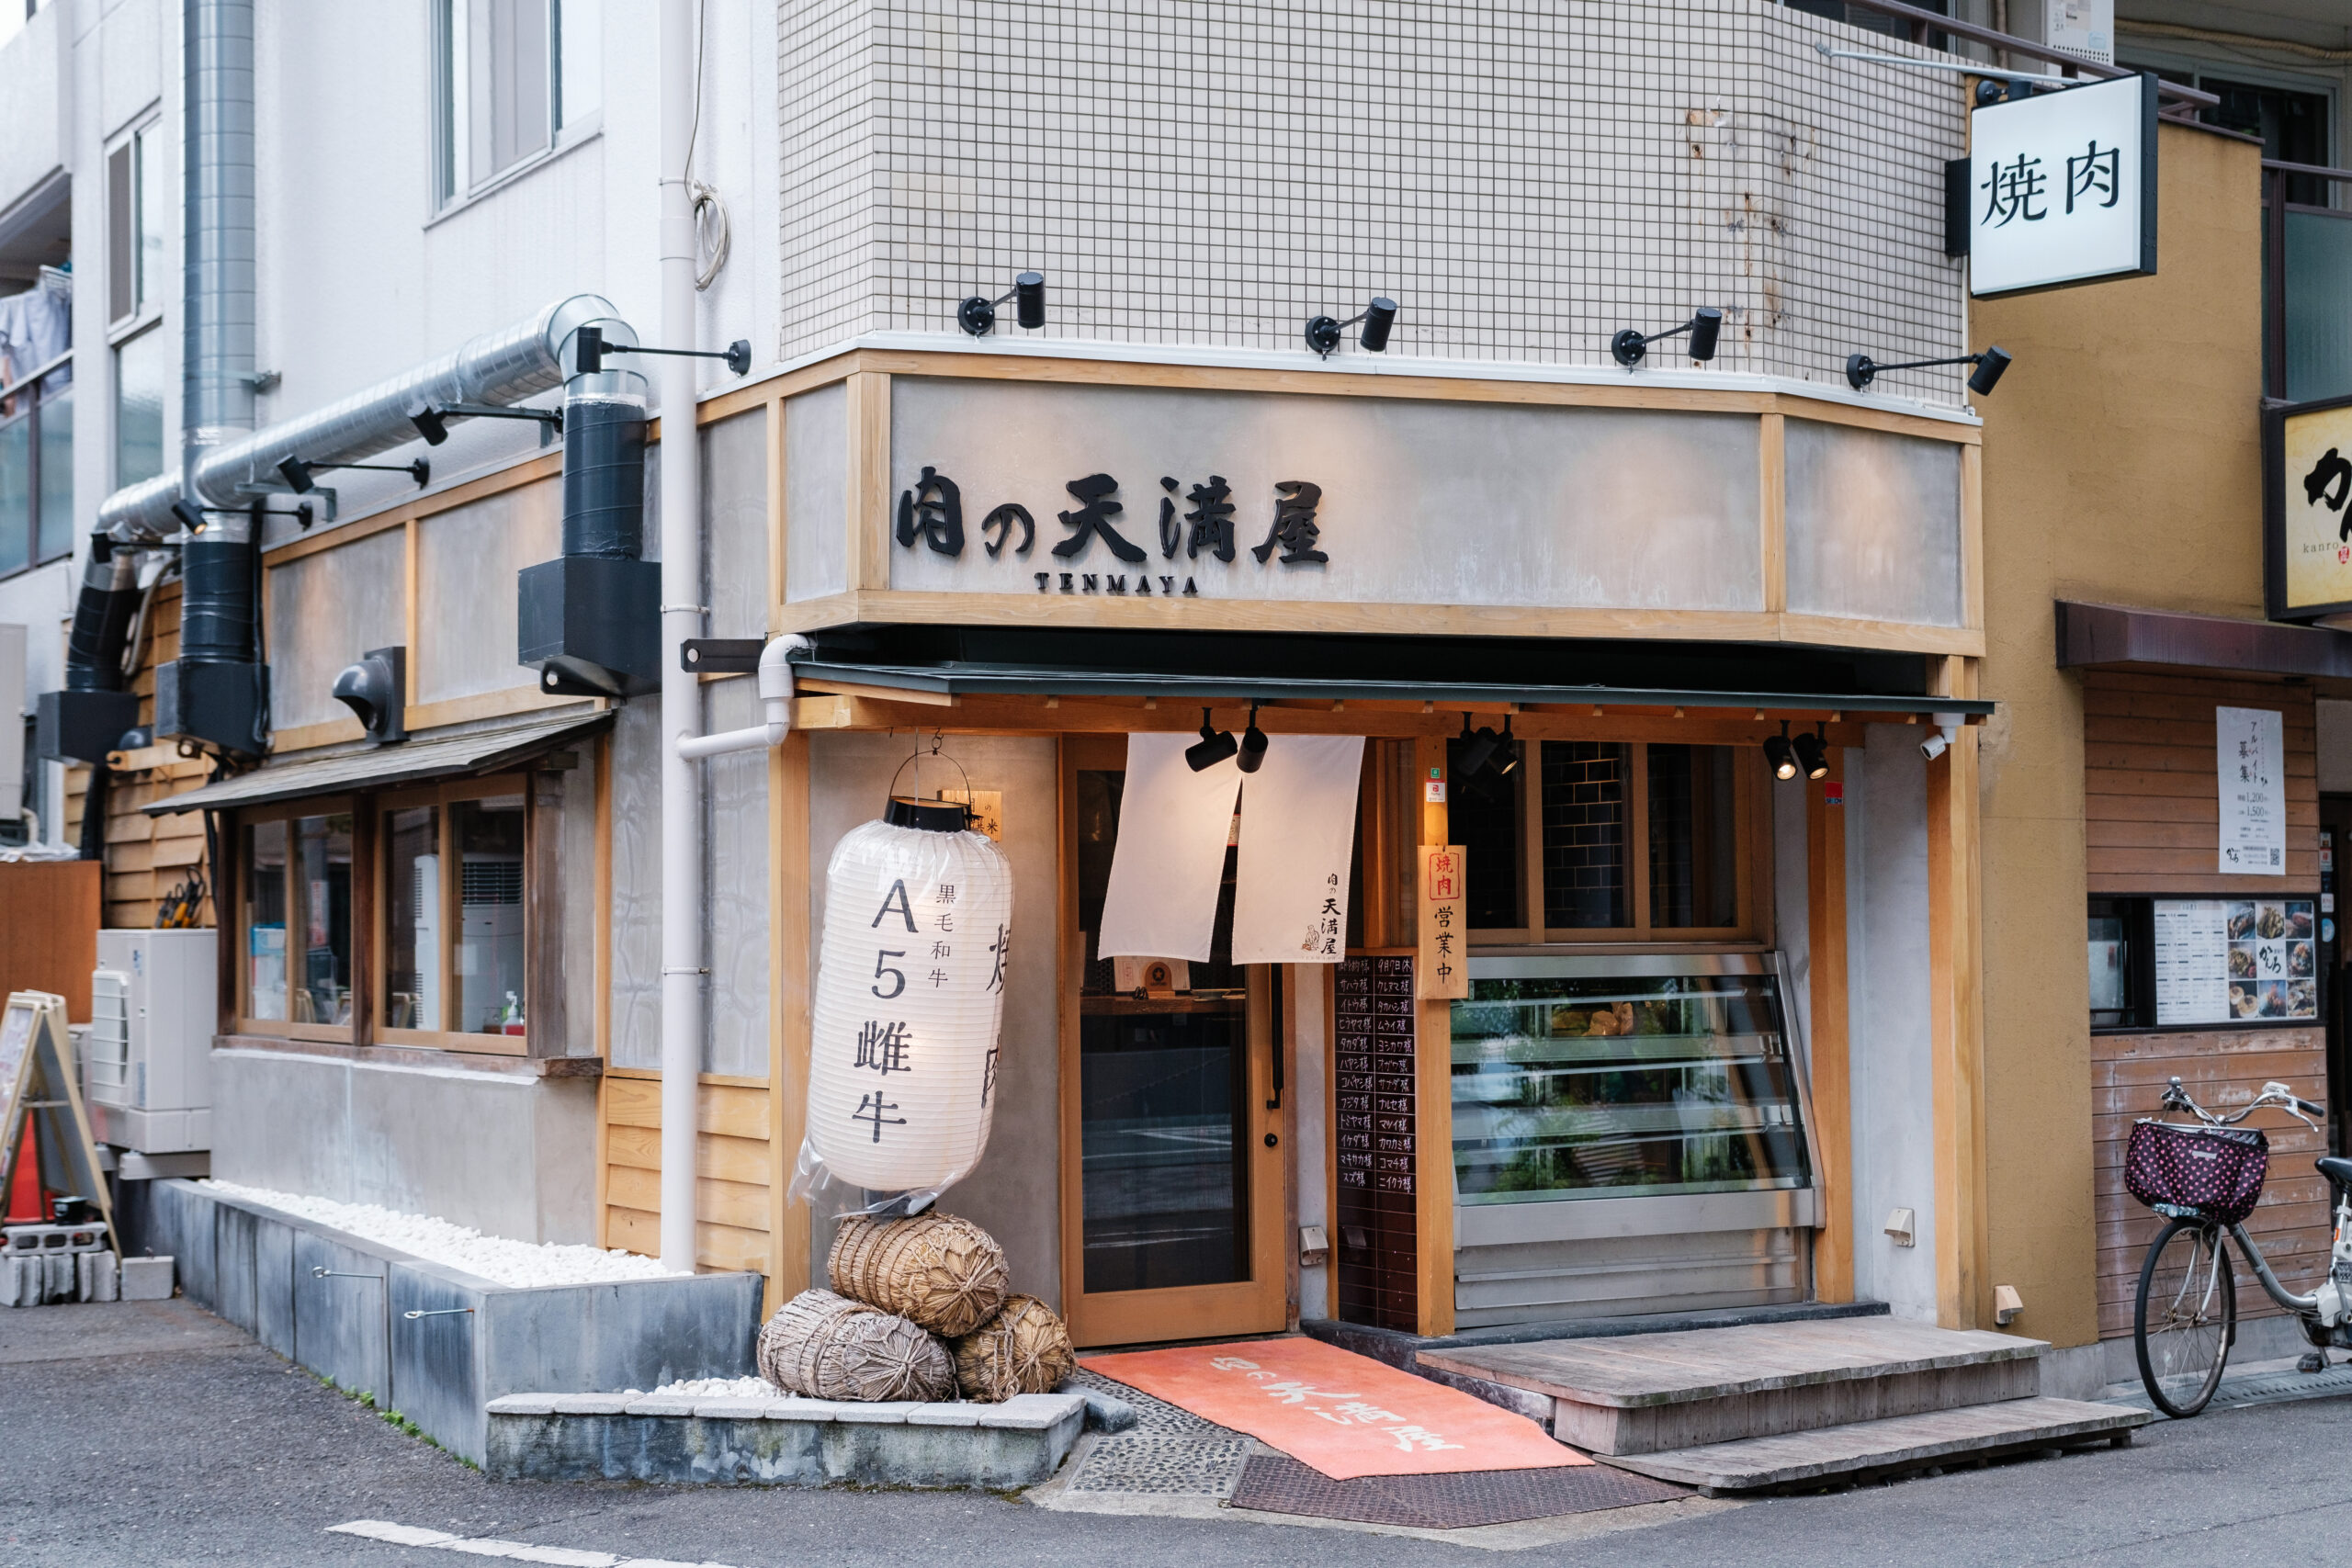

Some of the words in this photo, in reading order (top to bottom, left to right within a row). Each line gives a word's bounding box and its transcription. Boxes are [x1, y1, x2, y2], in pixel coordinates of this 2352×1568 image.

[1980, 140, 2120, 229] 焼肉
[896, 466, 1329, 564] 肉の天満屋
[2302, 541, 2339, 554] kanro
[1035, 571, 1198, 595] TENMAYA
[1320, 873, 1341, 954] 肉の天満屋
[1435, 856, 1453, 897] 焼肉
[928, 884, 956, 989] 黒毛和牛
[1434, 905, 1454, 985] 営業中
[853, 878, 920, 1145] A5雌牛
